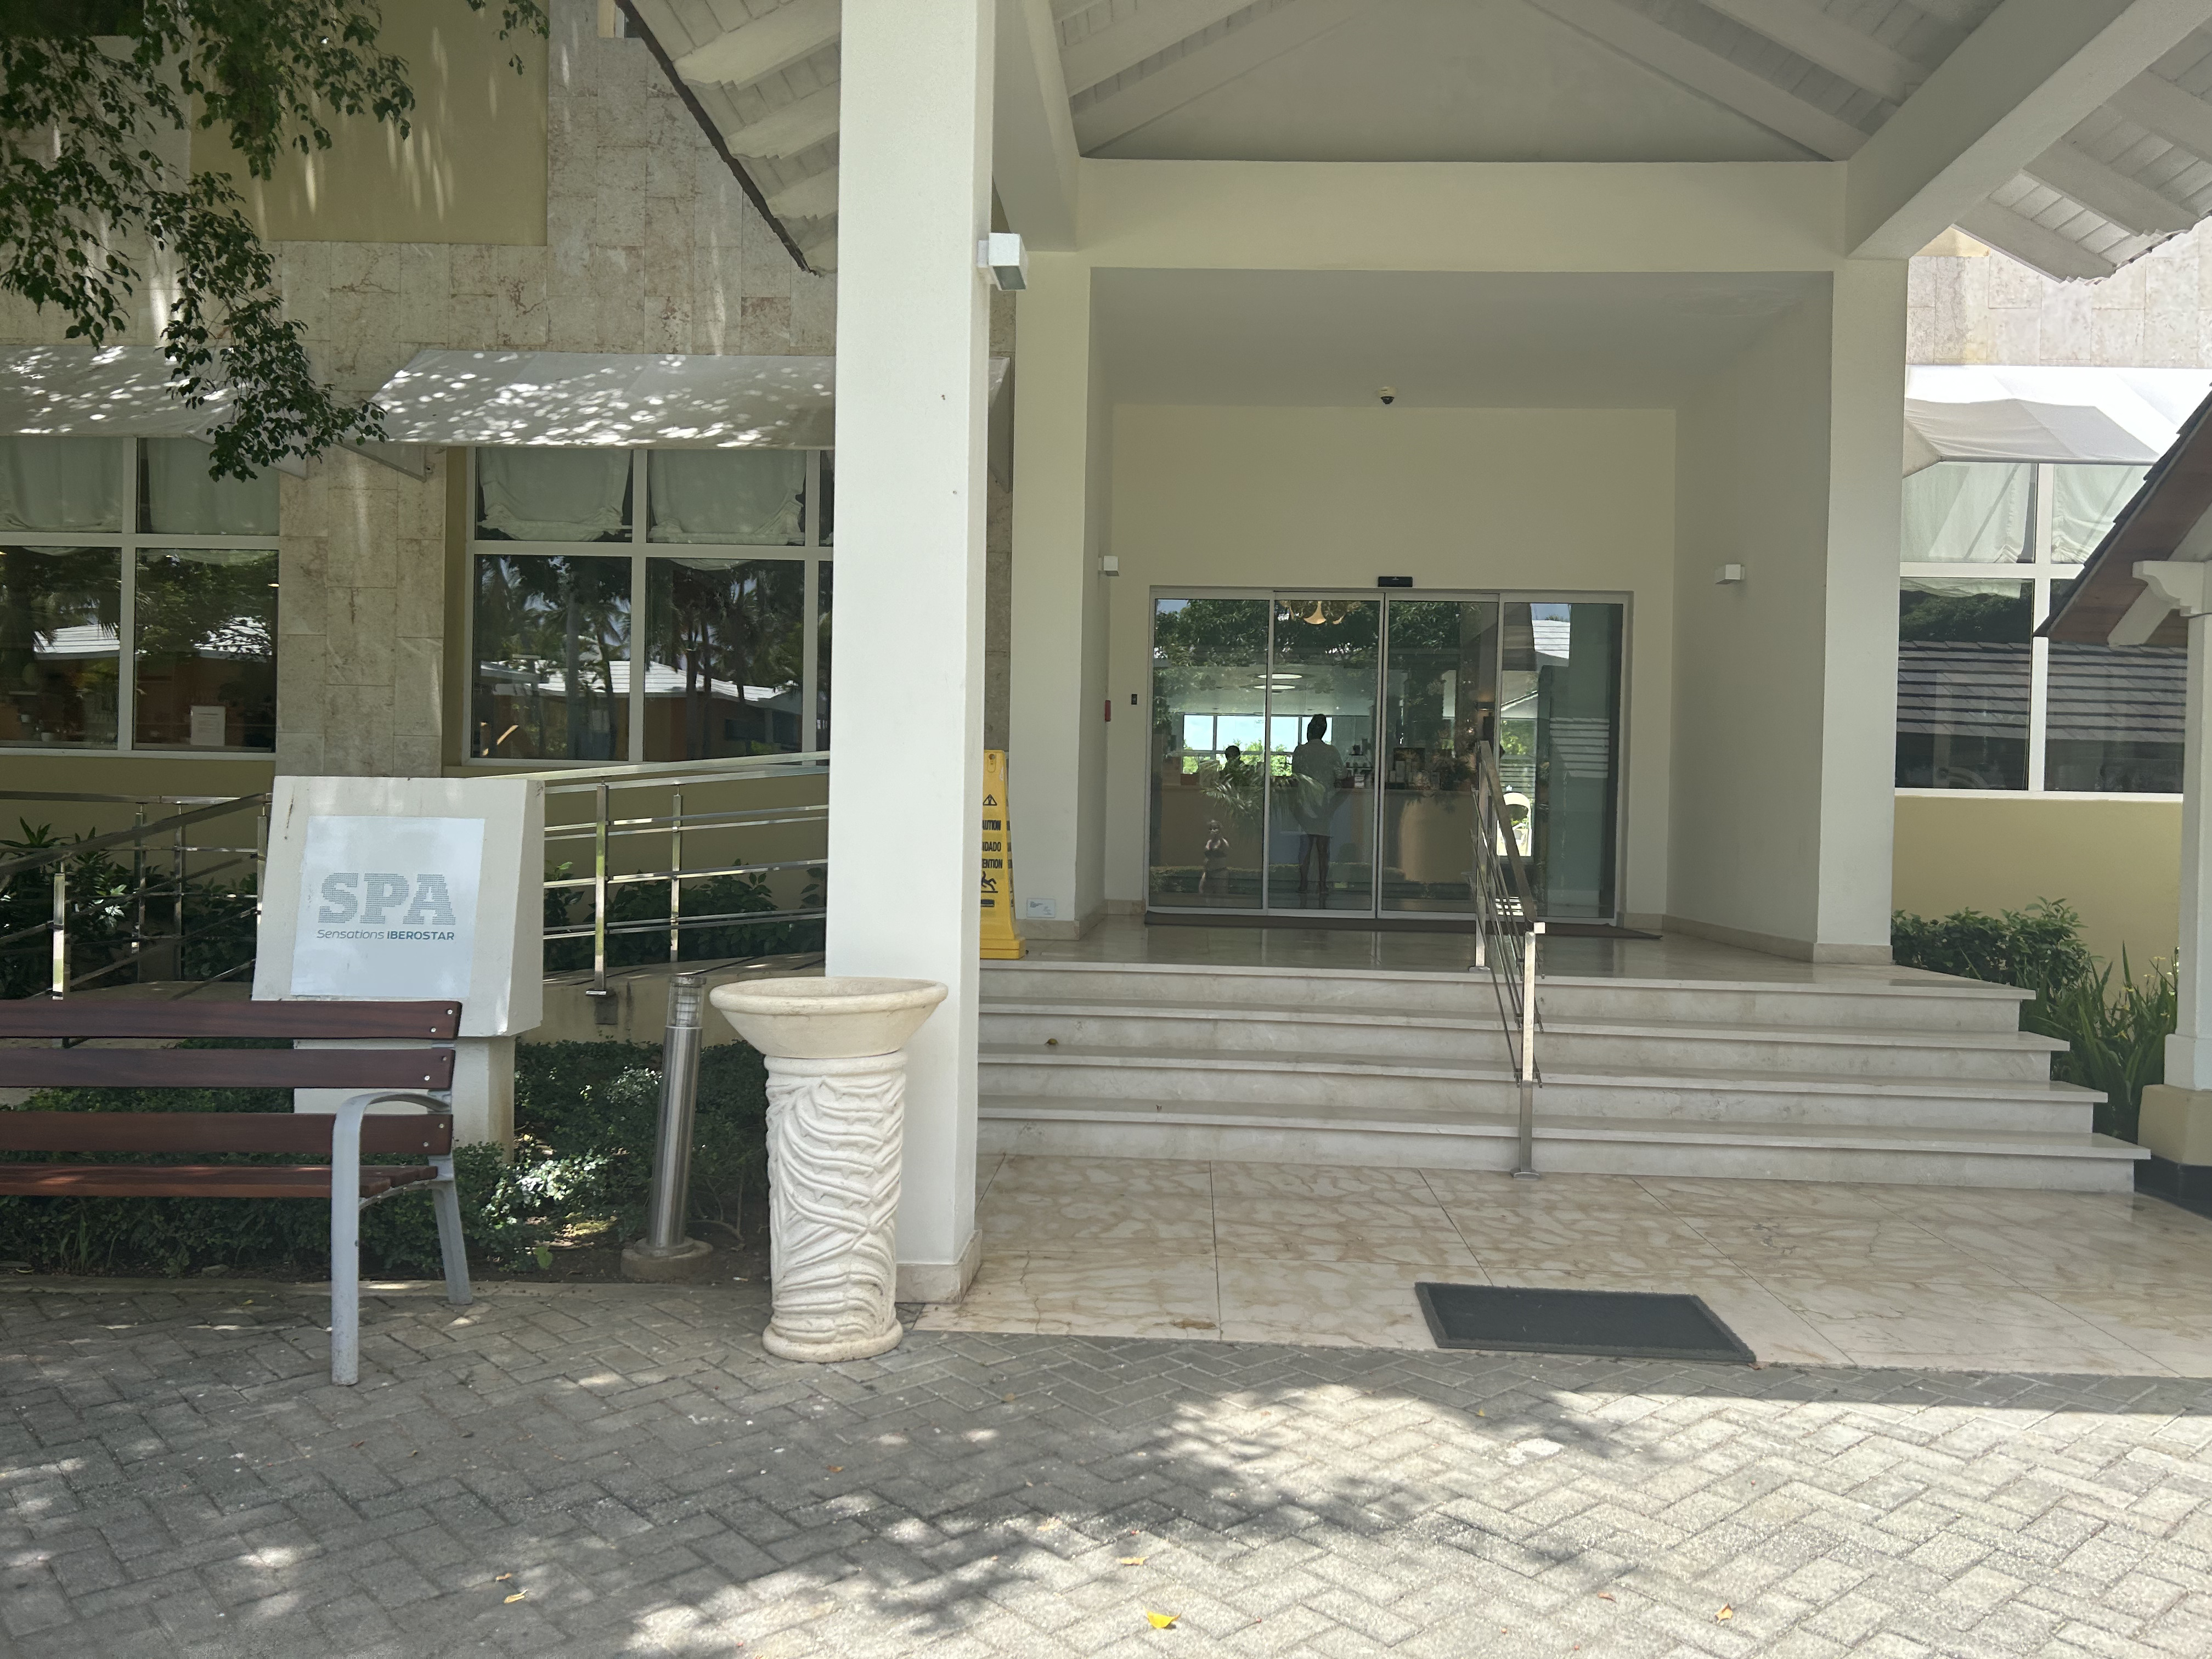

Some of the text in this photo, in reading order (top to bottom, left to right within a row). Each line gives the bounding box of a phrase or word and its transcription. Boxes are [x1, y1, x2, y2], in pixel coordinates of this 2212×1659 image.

[983, 820, 1001, 831] UTION
[982, 842, 1001, 851] IDADO
[982, 859, 1002, 869] ENTION
[318, 872, 456, 925] SPA
[317, 929, 455, 940] Sensations IBEROSTAR
